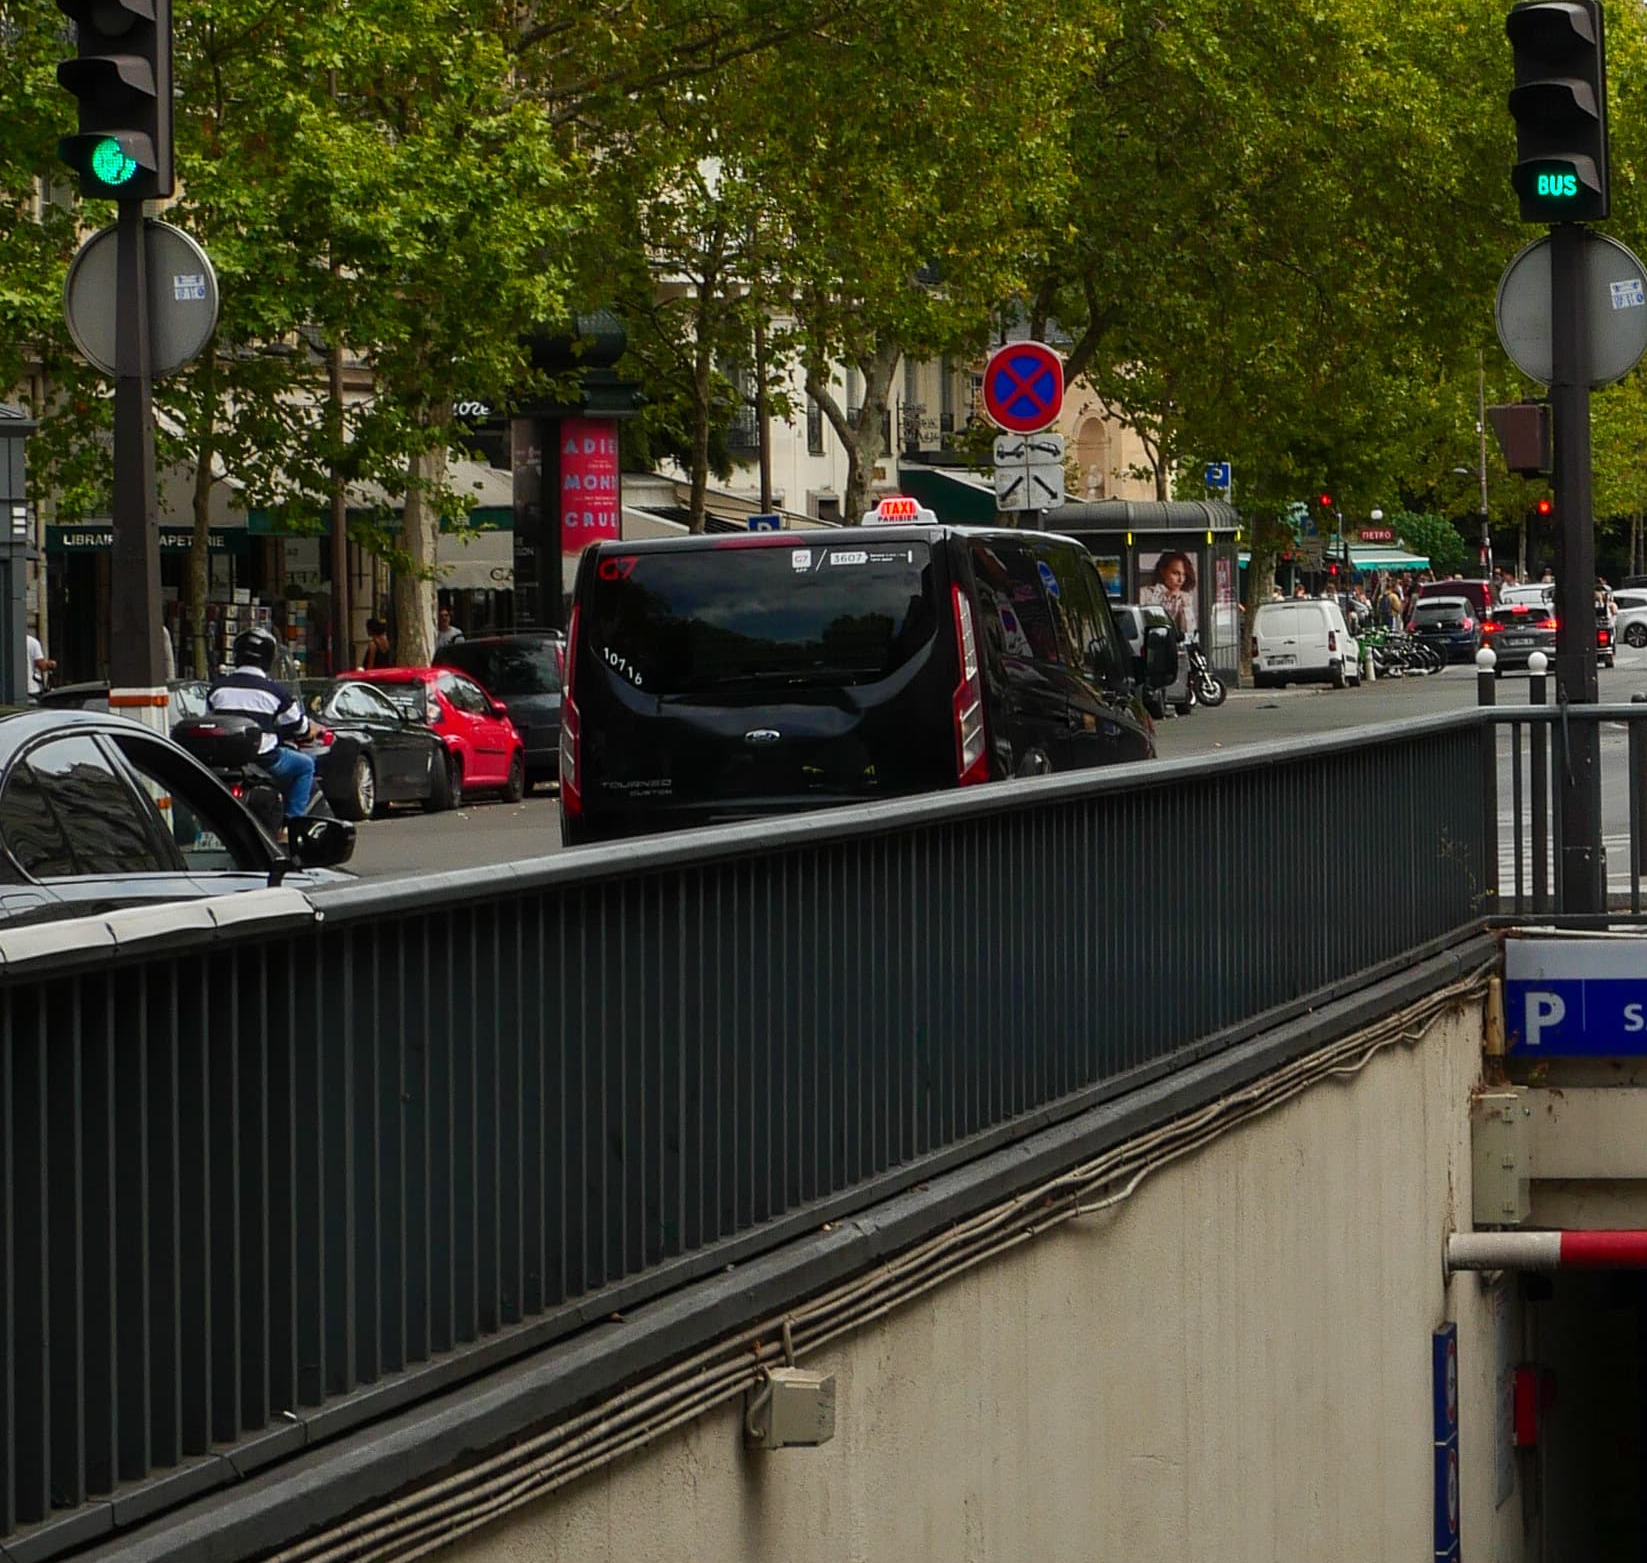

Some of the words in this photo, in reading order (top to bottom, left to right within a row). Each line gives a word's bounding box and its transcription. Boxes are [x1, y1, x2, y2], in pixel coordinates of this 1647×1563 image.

[1537, 175, 1577, 196] BUS
[885, 502, 913, 516] TAXI
[878, 515, 918, 523] PARISIEN
[833, 554, 862, 564] 3607
[599, 556, 639, 581] G7
[604, 647, 642, 685] 10716
[602, 778, 673, 789] TOURNEO
[1525, 991, 1566, 1046] P
